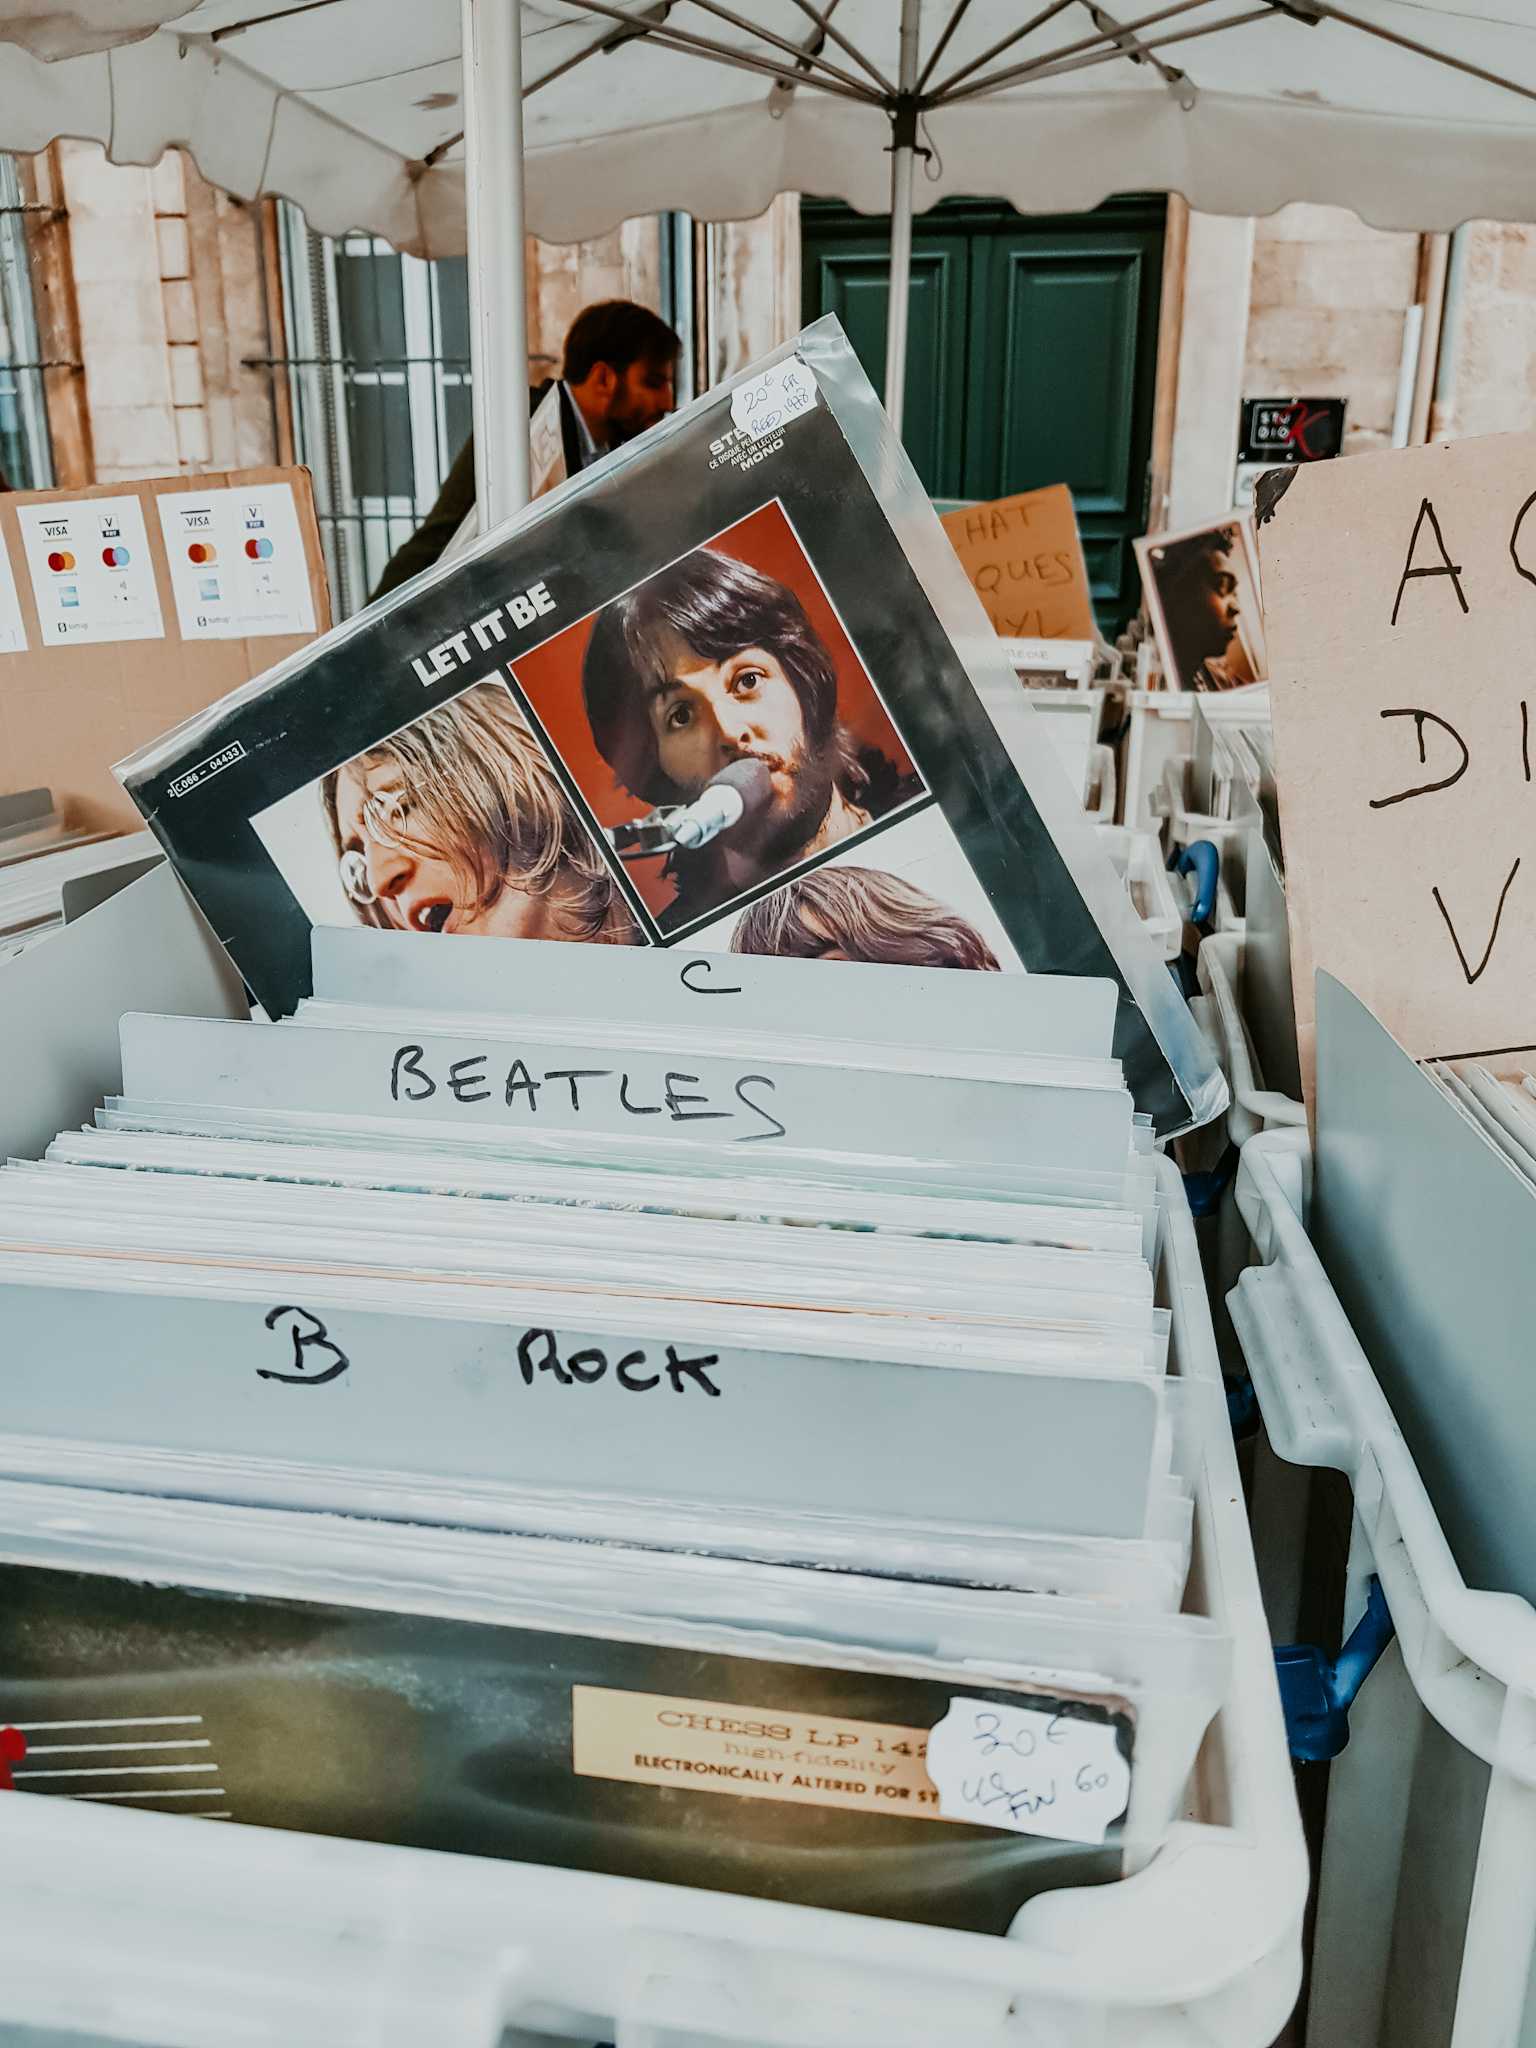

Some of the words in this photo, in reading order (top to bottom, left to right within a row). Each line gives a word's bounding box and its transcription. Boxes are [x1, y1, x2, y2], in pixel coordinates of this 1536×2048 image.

[708, 460, 720, 470] CE
[718, 443, 742, 464] DISQUE
[730, 451, 748, 466] AVEC
[747, 445, 757, 456] UN
[756, 427, 786, 449] LECTEUR
[740, 438, 784, 472] MONO
[45, 526, 68, 537] VISA
[186, 517, 210, 527] VISA
[411, 630, 472, 687] LET
[470, 608, 507, 651] IT
[505, 581, 557, 630] BE
[209, 747, 240, 770] 04433
[1432, 857, 1520, 984] V
[680, 959, 742, 994] C
[390, 1044, 786, 1143] BEATLES
[256, 1305, 350, 1385] B
[517, 1327, 721, 1397] ROCK
[656, 1709, 791, 1742] CHESS
[807, 1727, 859, 1748] LP
[634, 1753, 785, 1785] ELECTRONICALLY
[792, 1774, 867, 1795] ALTERED
[875, 1784, 910, 1799] FOR
[1075, 1764, 1109, 1792] 60
